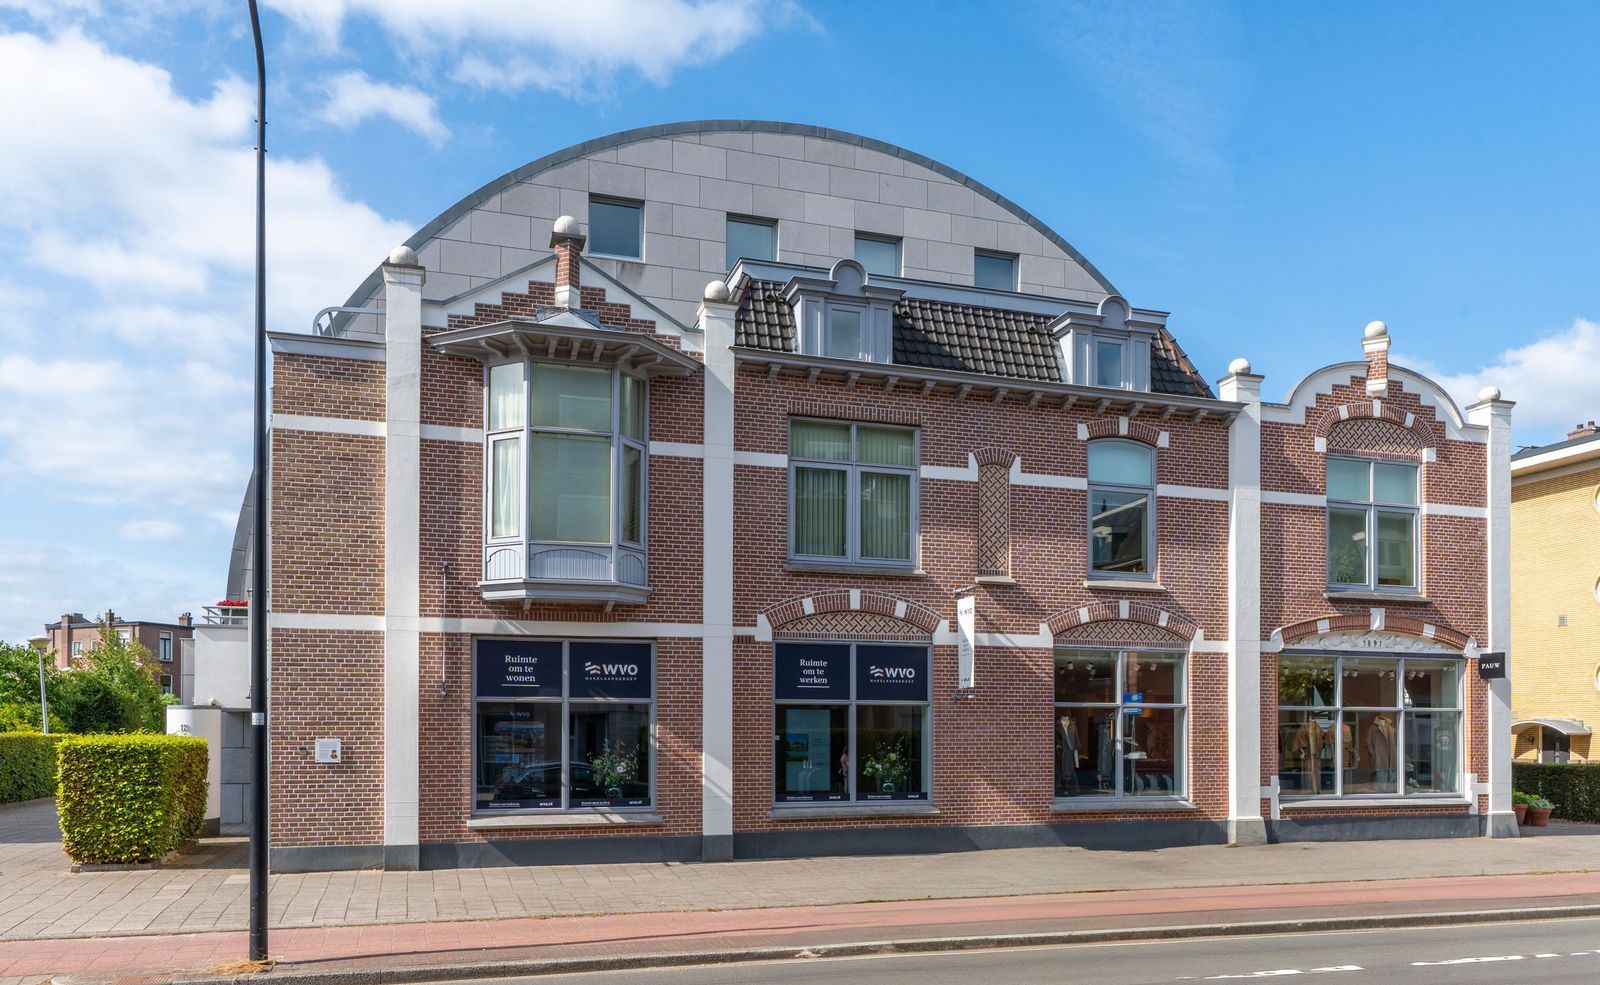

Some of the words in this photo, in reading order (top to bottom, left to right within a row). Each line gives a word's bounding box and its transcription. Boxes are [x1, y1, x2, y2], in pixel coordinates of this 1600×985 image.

[1362, 639, 1382, 648] 1891
[504, 655, 538, 664] Ruimte
[799, 659, 828, 667] Ruimte
[508, 665, 523, 673] om
[524, 665, 534, 673] te
[602, 664, 639, 676] WVO
[885, 667, 915, 678] WVO
[506, 674, 536, 682] wonen
[799, 676, 828, 684] werken
